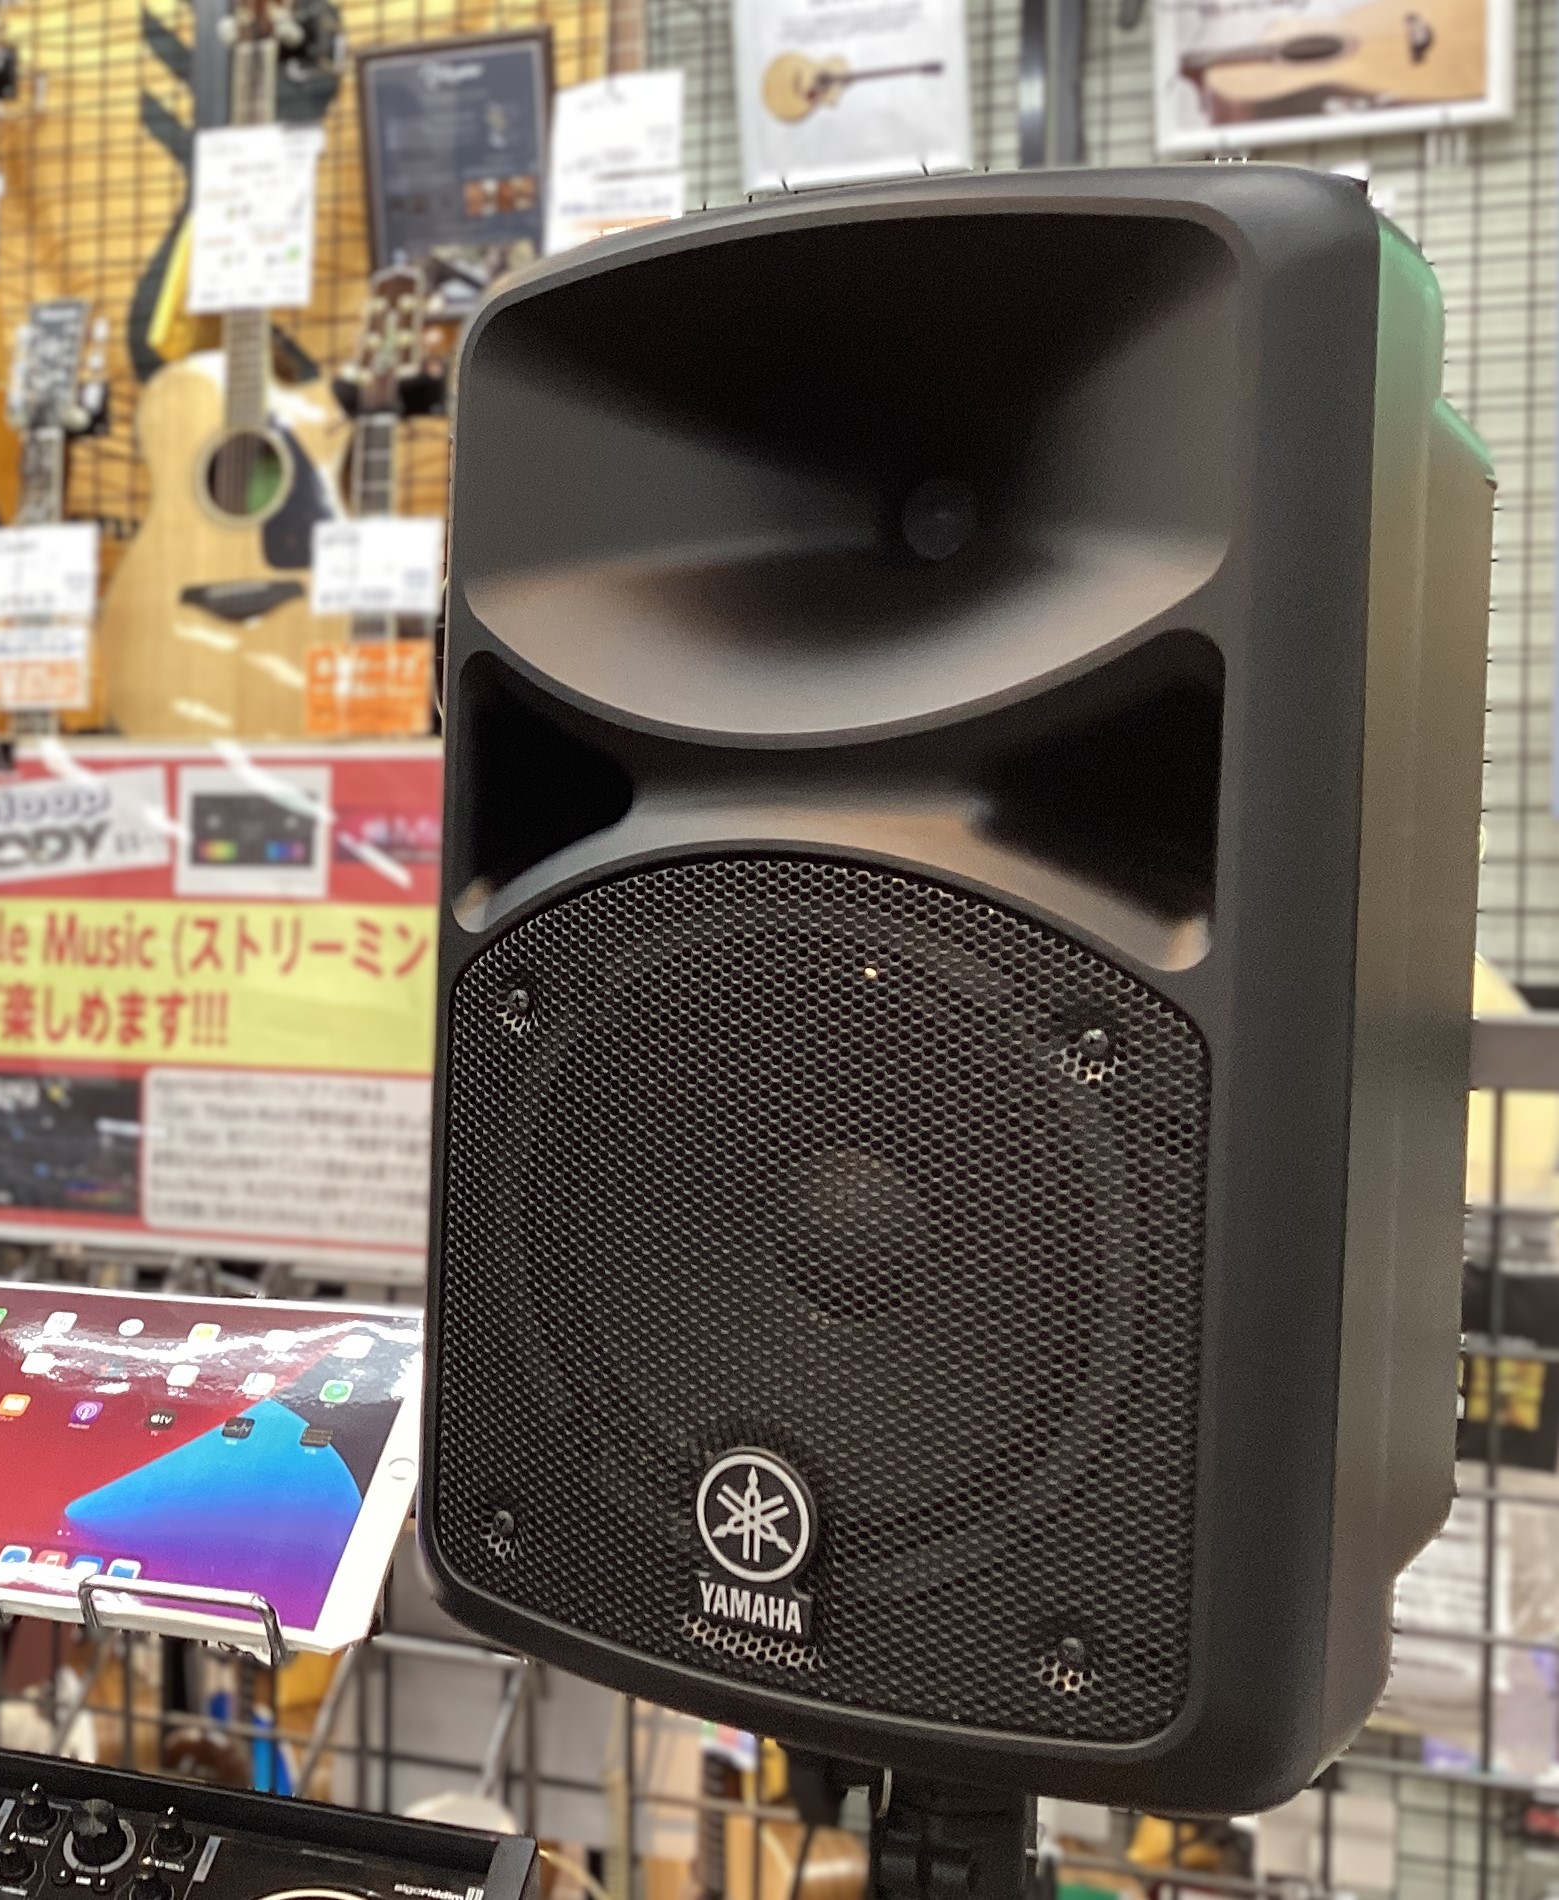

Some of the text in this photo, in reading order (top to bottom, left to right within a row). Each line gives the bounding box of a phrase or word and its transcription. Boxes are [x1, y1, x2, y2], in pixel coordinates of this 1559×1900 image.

[43, 911, 156, 969] Music
[172, 914, 430, 978] (ストリーミン
[699, 1580, 802, 1634] YAMAHA
